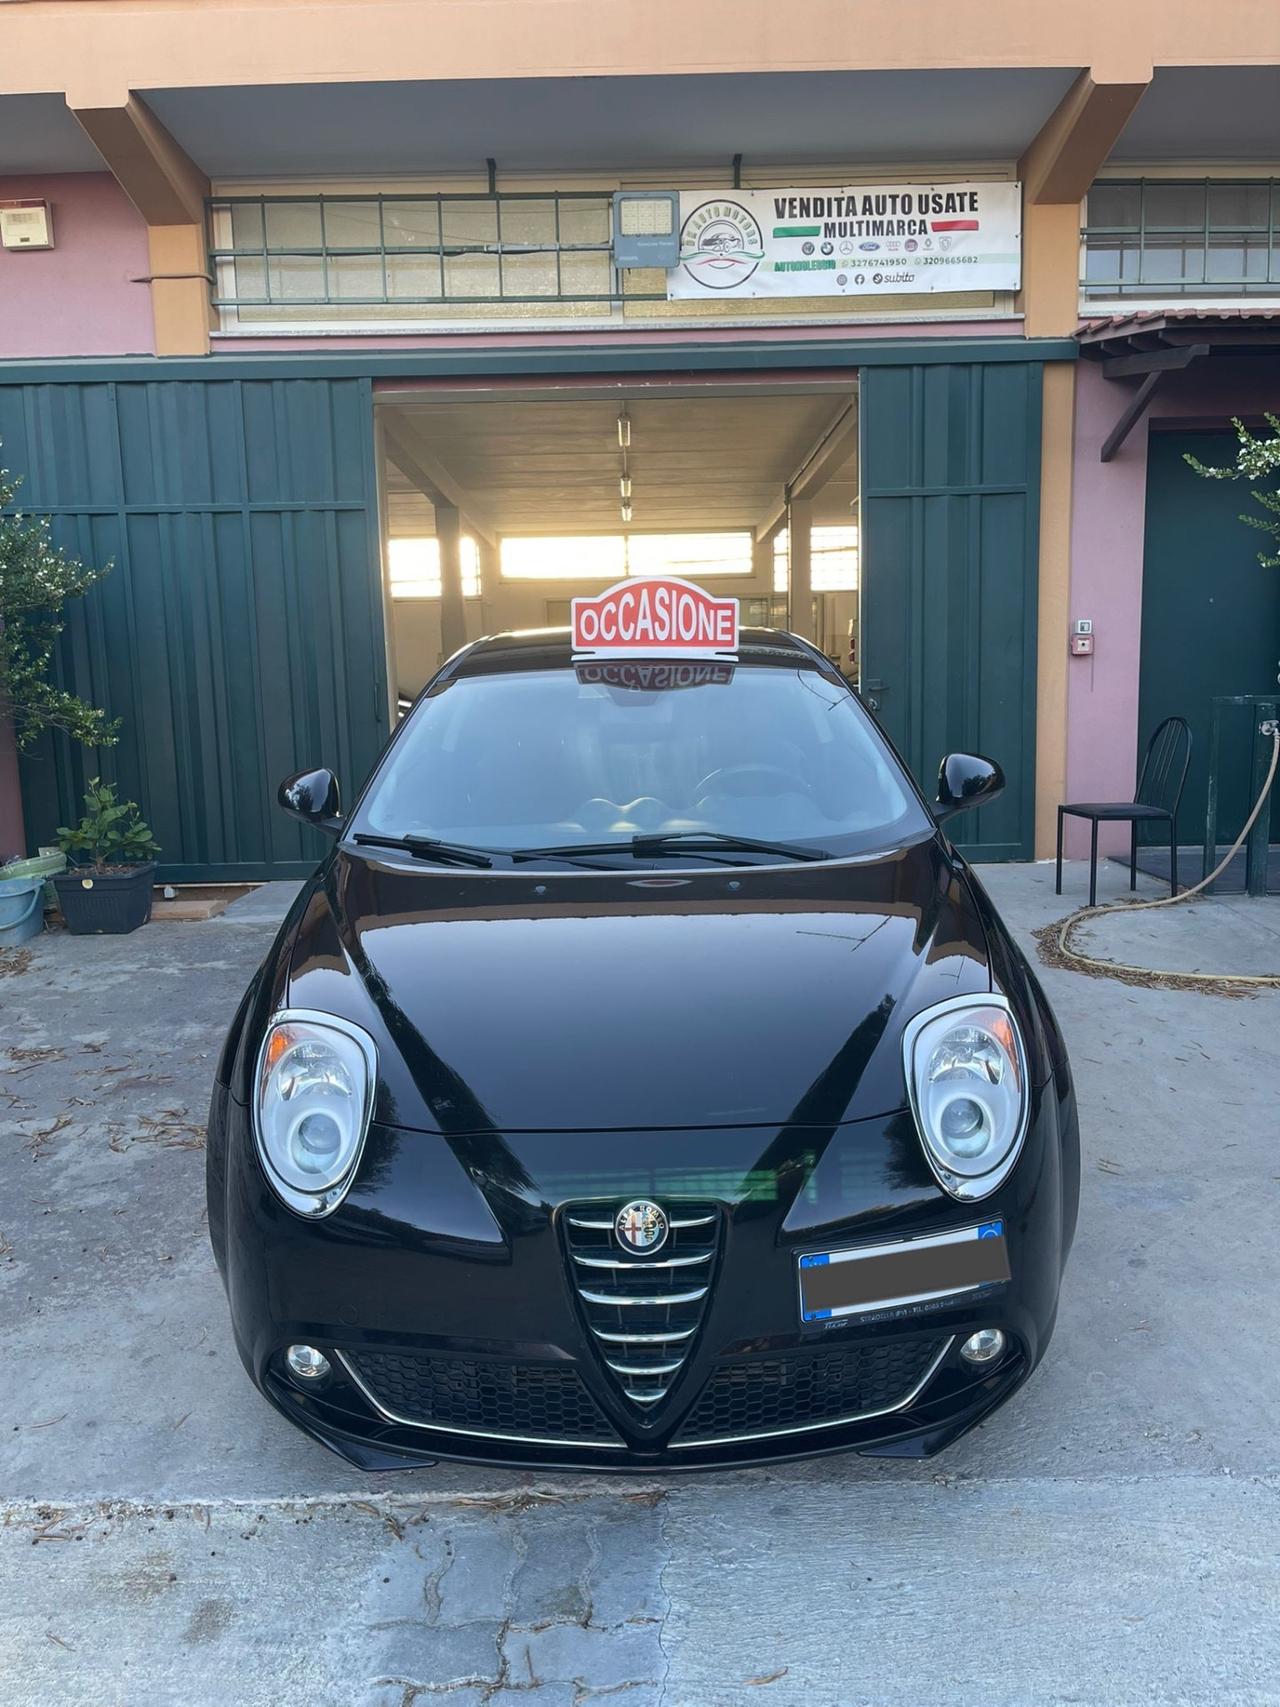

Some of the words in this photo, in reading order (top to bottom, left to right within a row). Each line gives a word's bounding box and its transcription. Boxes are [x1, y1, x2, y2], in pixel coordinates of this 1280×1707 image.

[774, 196, 857, 219] VENDITA
[862, 193, 913, 216] AUTO
[918, 191, 978, 214] USATE
[824, 219, 928, 238] MULTIMARCA
[851, 258, 907, 267] 3276741950
[883, 272, 915, 283] subito
[580, 587, 732, 641] OCCASIONE
[619, 1208, 635, 1231] ALFA
[639, 1205, 665, 1229] ROMEO
